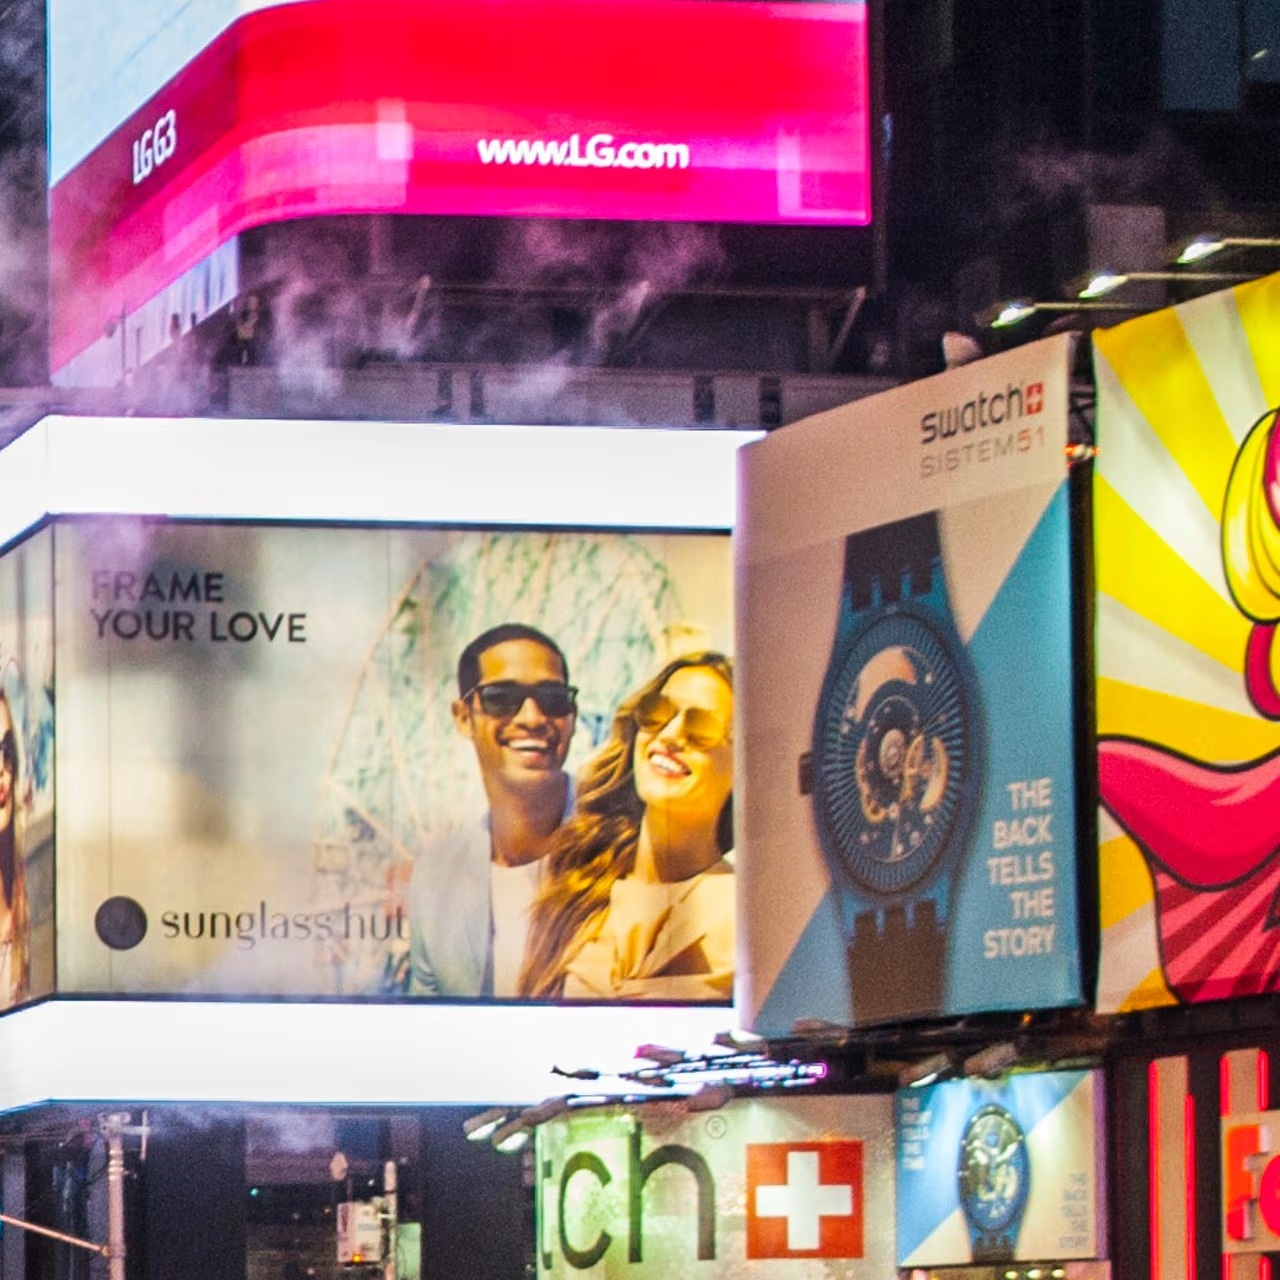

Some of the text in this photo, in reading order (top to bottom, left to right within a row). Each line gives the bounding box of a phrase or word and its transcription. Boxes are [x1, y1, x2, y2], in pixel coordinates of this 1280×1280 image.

[477, 133, 690, 170] www.LG.com
[920, 384, 1024, 445] swatch
[920, 426, 1045, 478] SISTEM51
[92, 570, 224, 603] FRAME
[91, 609, 308, 643] YOUR LOVE
[1008, 777, 1053, 811] THE
[993, 815, 1053, 850] BACK
[987, 851, 1055, 886] TELLS
[1010, 887, 1055, 919] THE
[161, 900, 410, 950] sunglass hut
[983, 924, 1056, 959] STORY
